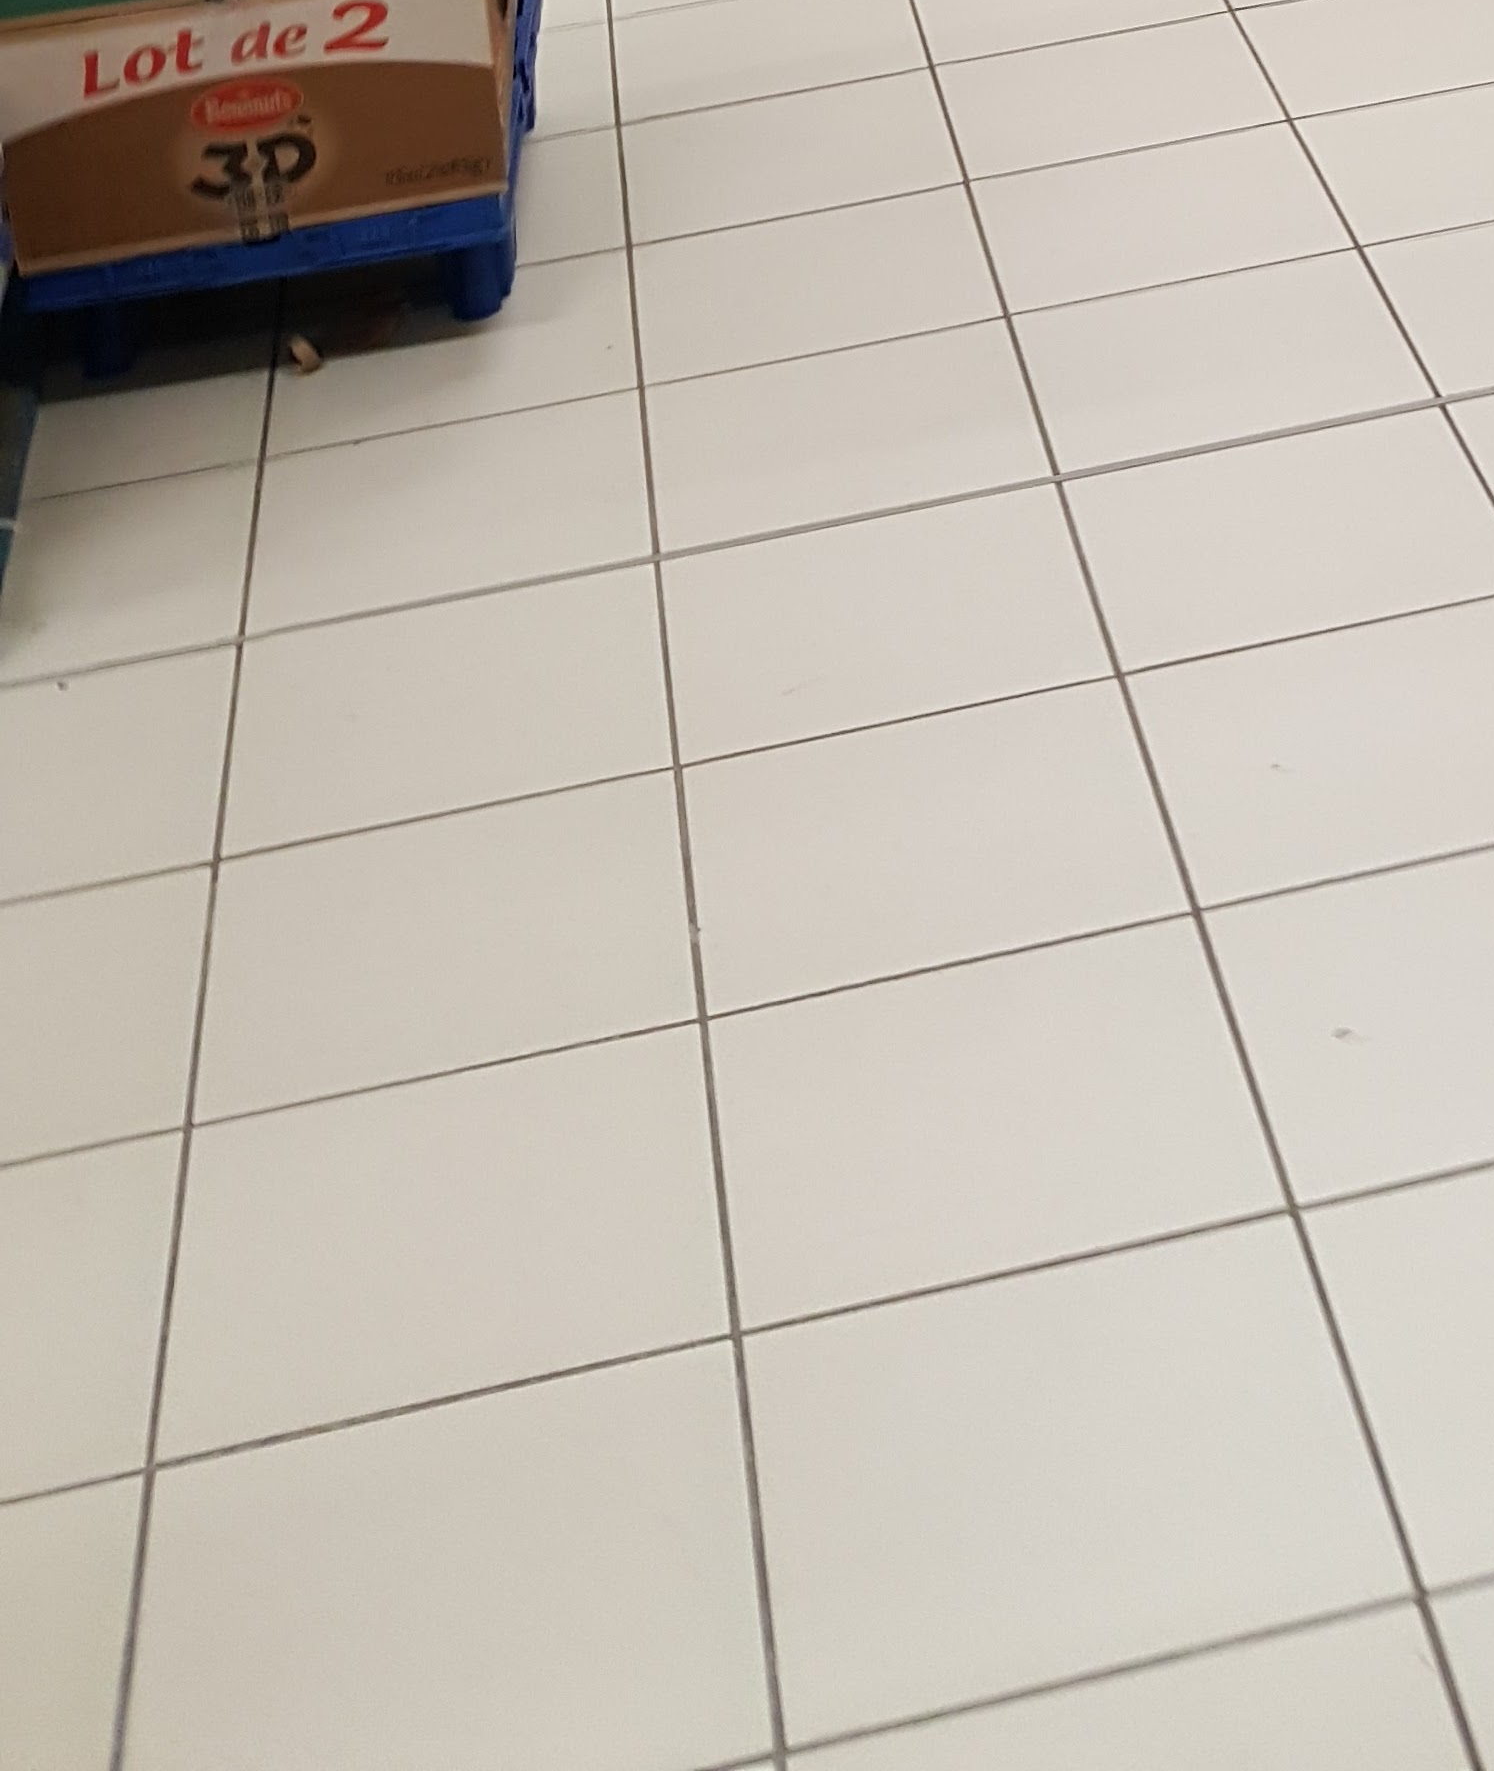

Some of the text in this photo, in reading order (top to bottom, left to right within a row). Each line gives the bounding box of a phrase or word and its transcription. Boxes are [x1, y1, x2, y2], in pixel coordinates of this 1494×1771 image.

[81, 0, 391, 99] Lot de 2
[190, 133, 317, 203] 3D
